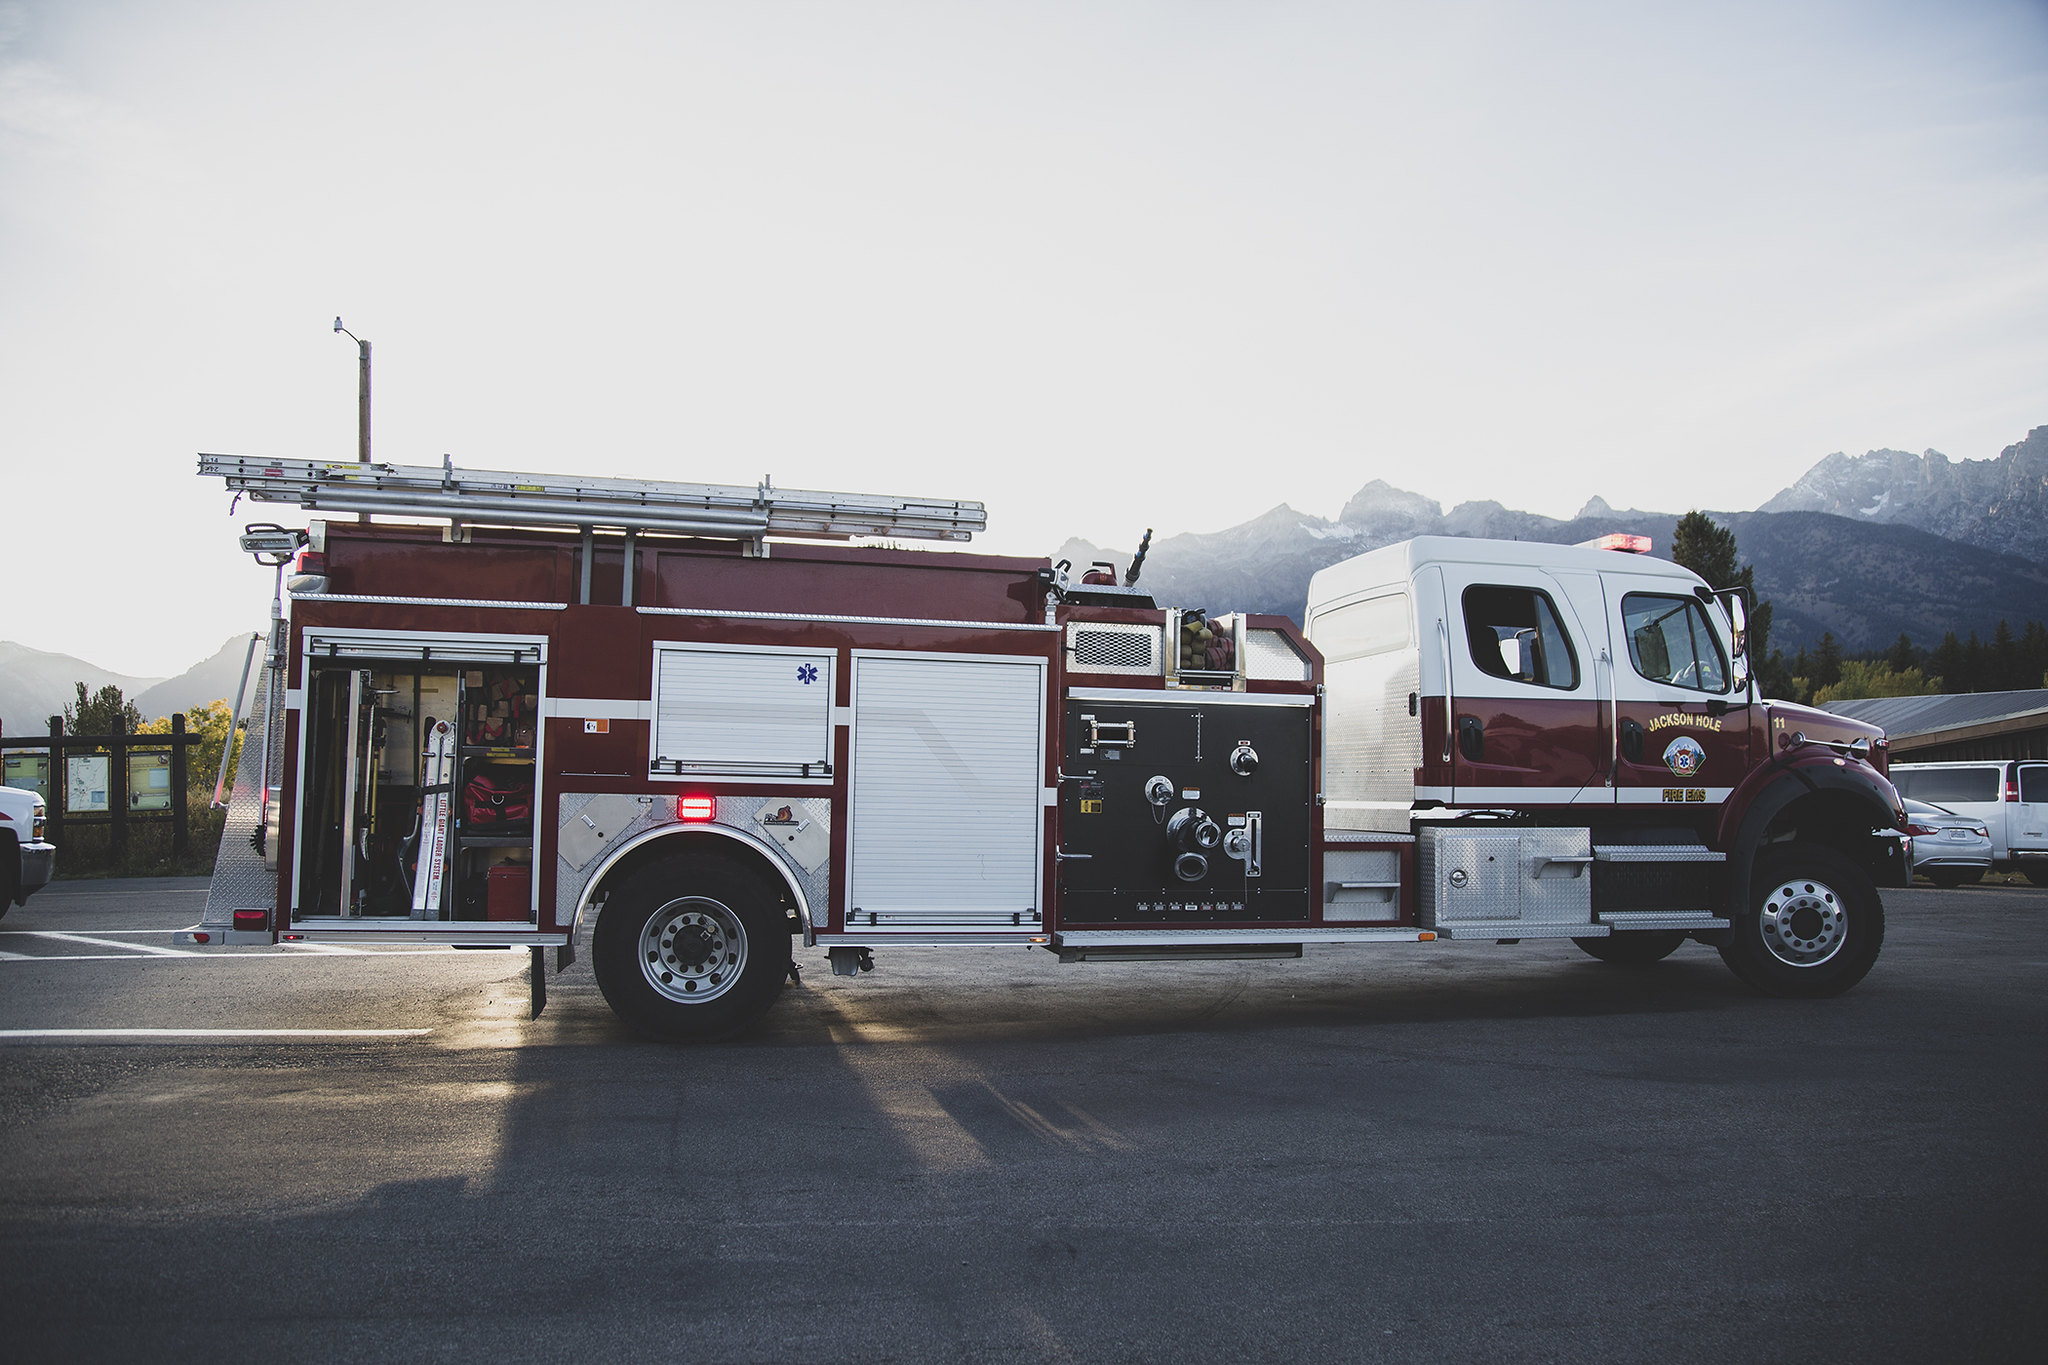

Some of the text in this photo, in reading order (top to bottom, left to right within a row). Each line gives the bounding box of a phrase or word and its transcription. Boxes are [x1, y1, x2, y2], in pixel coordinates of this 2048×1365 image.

[1649, 713, 1722, 732] JACKSON HOLE
[1774, 717, 1785, 728] 11
[1662, 789, 1706, 802] FIRE EMS
[435, 837, 443, 857] LADDER
[433, 859, 441, 879] SYSTEM
